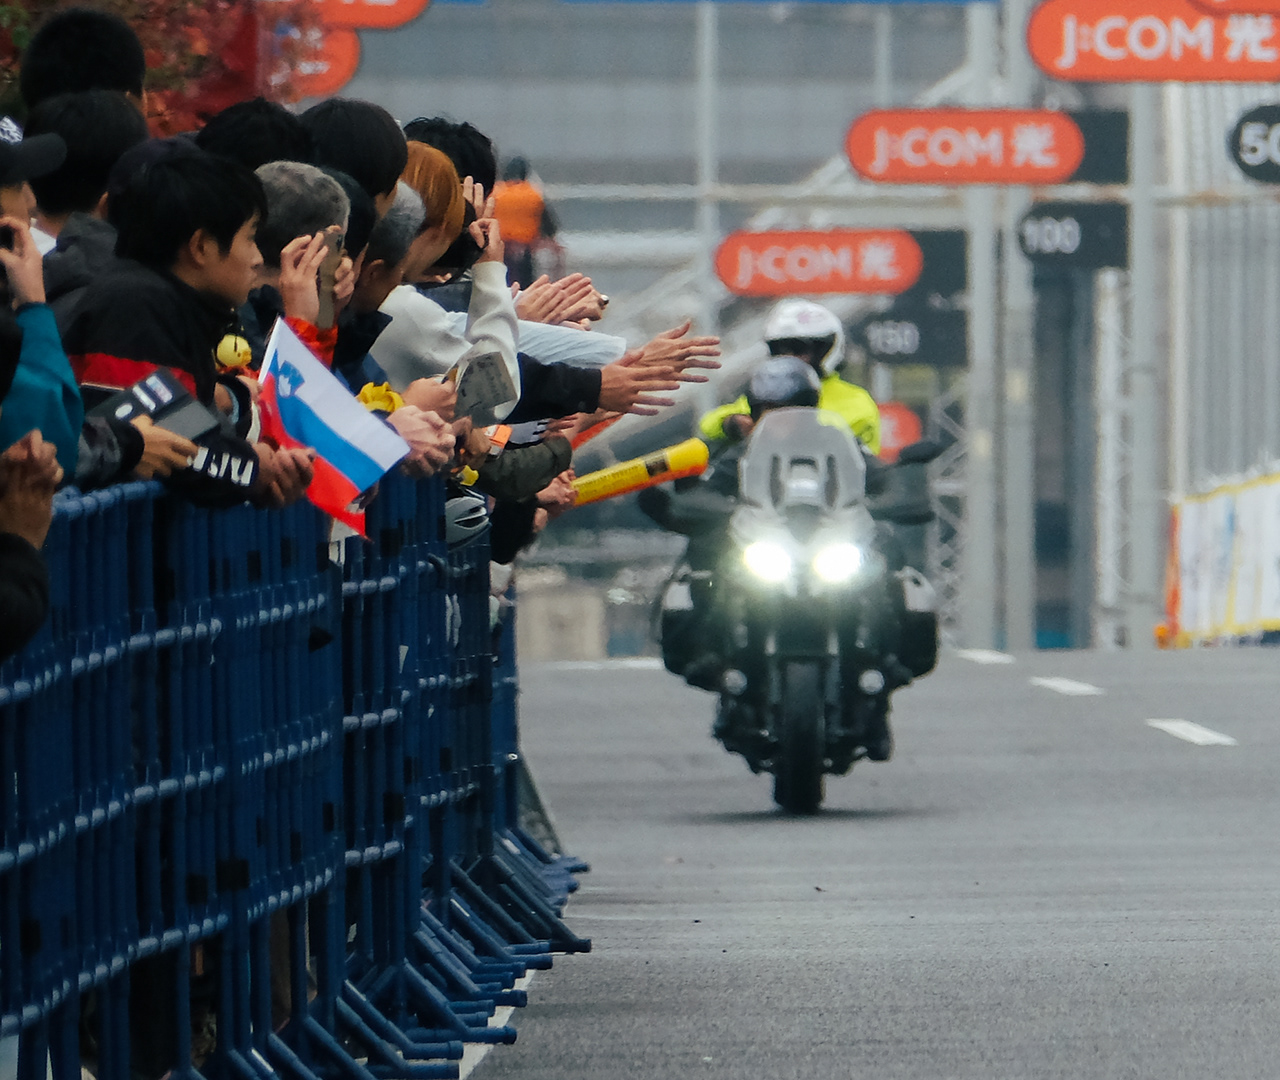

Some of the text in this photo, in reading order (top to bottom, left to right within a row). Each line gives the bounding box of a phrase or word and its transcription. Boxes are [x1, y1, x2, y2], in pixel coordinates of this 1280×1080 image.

[1054, 14, 1280, 69] J:COM 光
[869, 126, 1004, 174] J:COM
[1023, 217, 1082, 254] 100
[735, 246, 853, 290] J:COM
